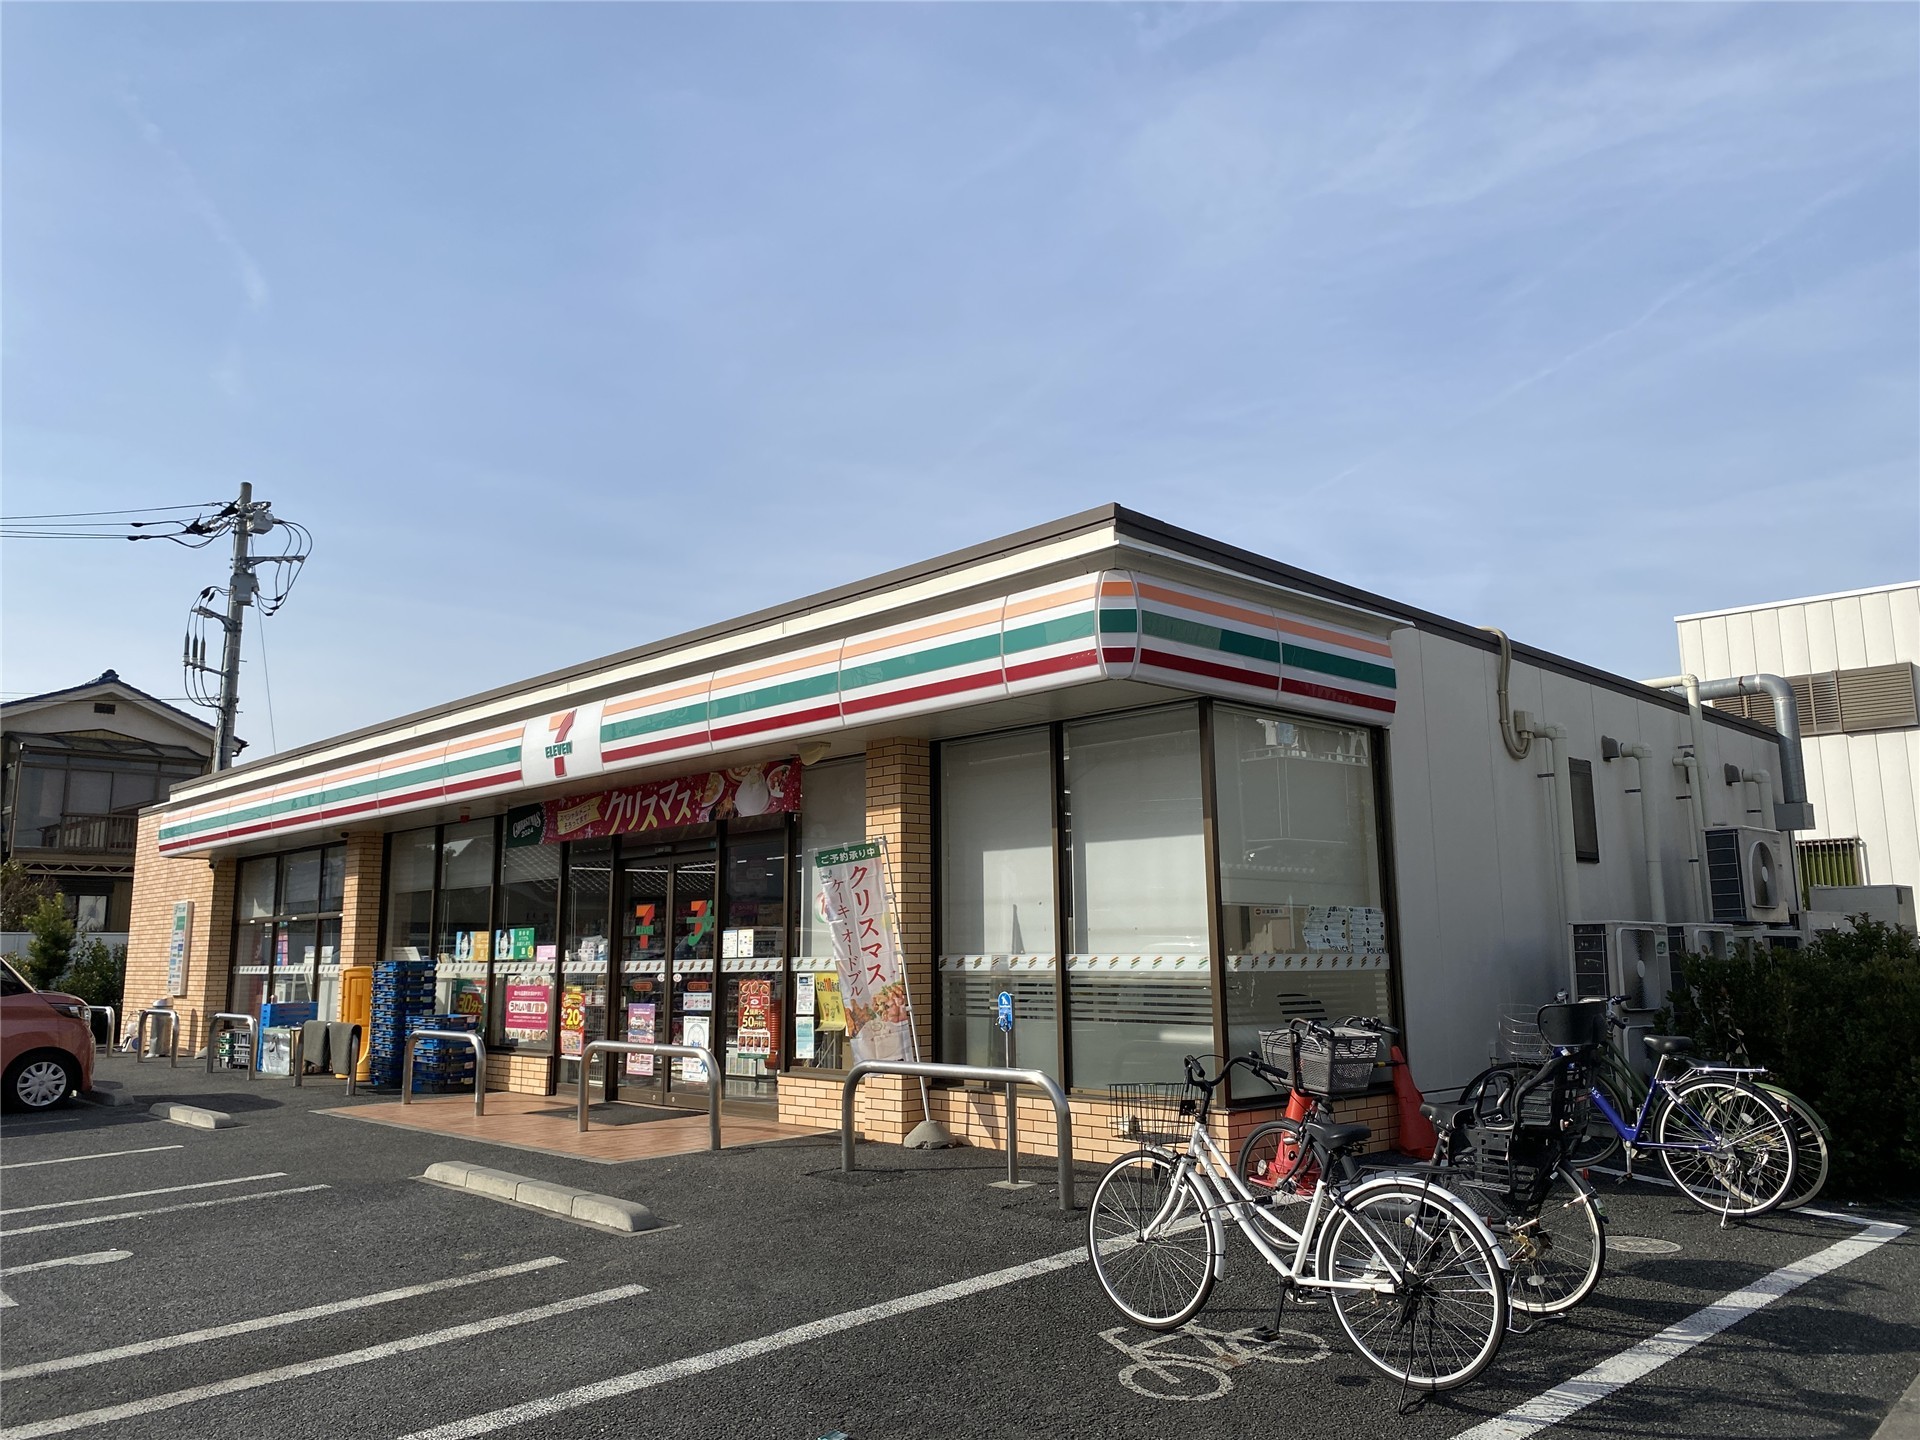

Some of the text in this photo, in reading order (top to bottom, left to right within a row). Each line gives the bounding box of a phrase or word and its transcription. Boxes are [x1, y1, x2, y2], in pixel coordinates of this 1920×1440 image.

[521, 827, 534, 838] 2024
[604, 781, 691, 835] クリスマス
[821, 847, 875, 864] ご予約承り中
[832, 878, 863, 997] ケーキ・オードブル
[850, 865, 886, 986] クリスマス
